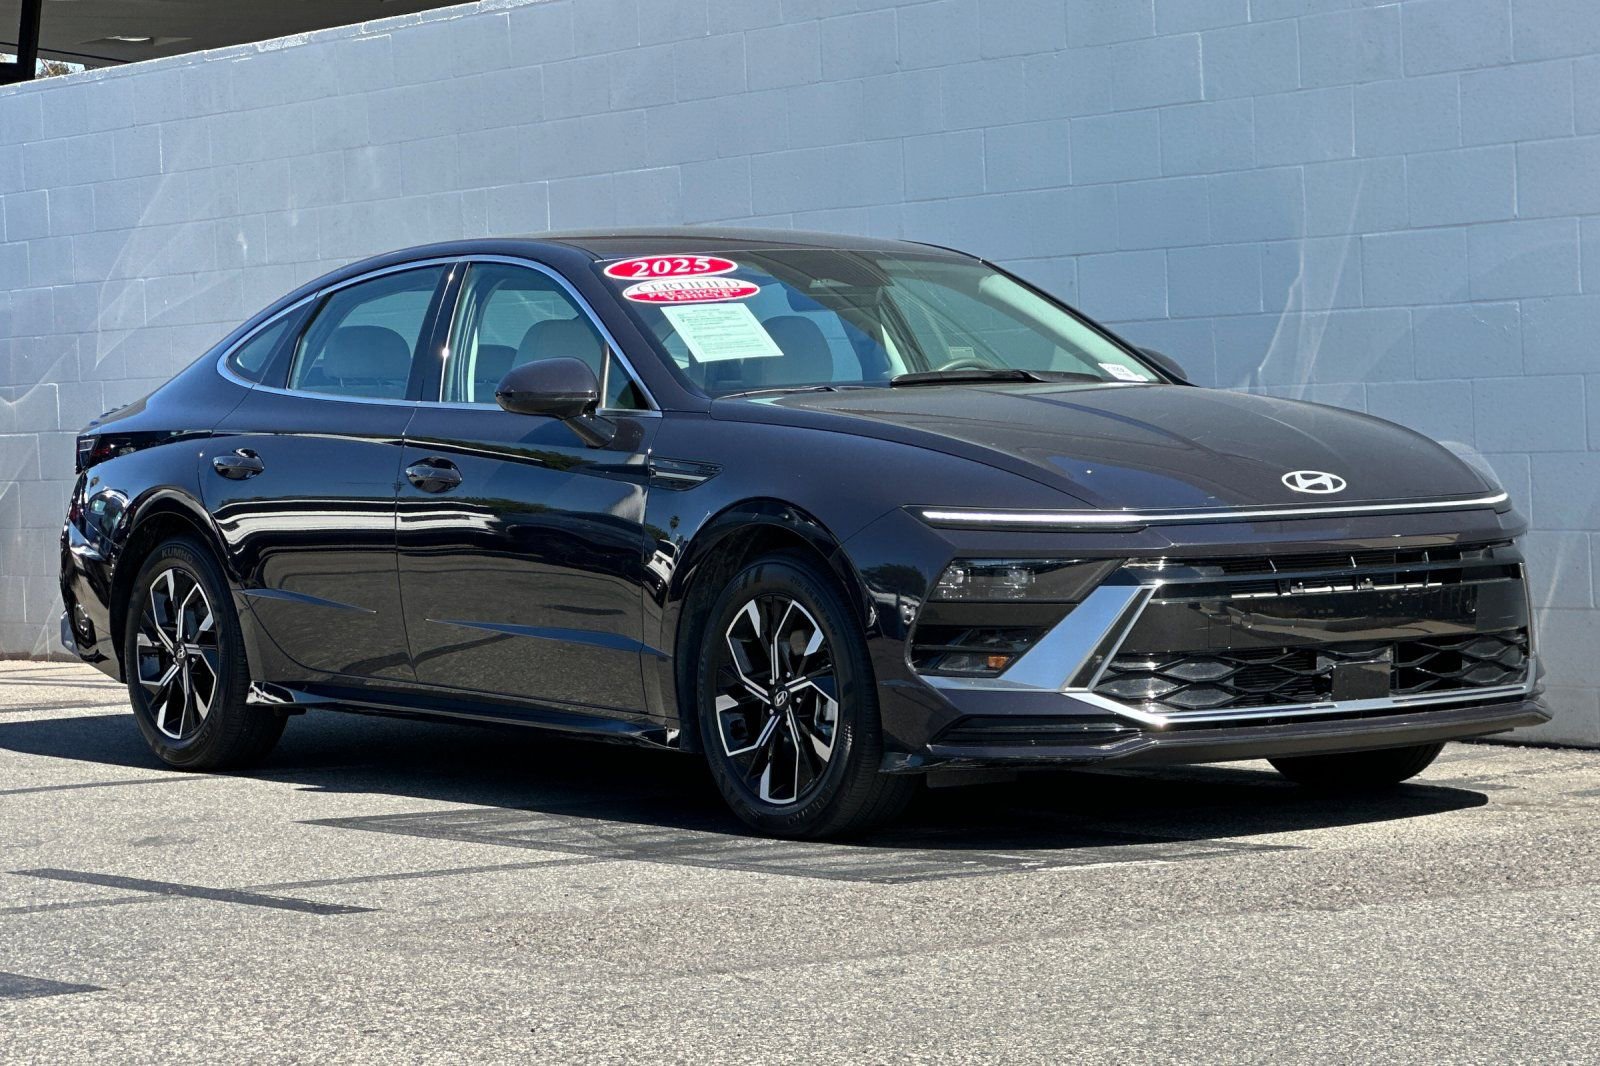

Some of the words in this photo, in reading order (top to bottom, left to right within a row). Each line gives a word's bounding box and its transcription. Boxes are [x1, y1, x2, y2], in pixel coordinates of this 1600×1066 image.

[632, 258, 711, 277] 2025
[637, 280, 740, 292] CERTIFIED
[647, 287, 741, 298] PRE-OWNED
[663, 292, 732, 301] VEHICLE
[161, 547, 193, 564] KUMHO
